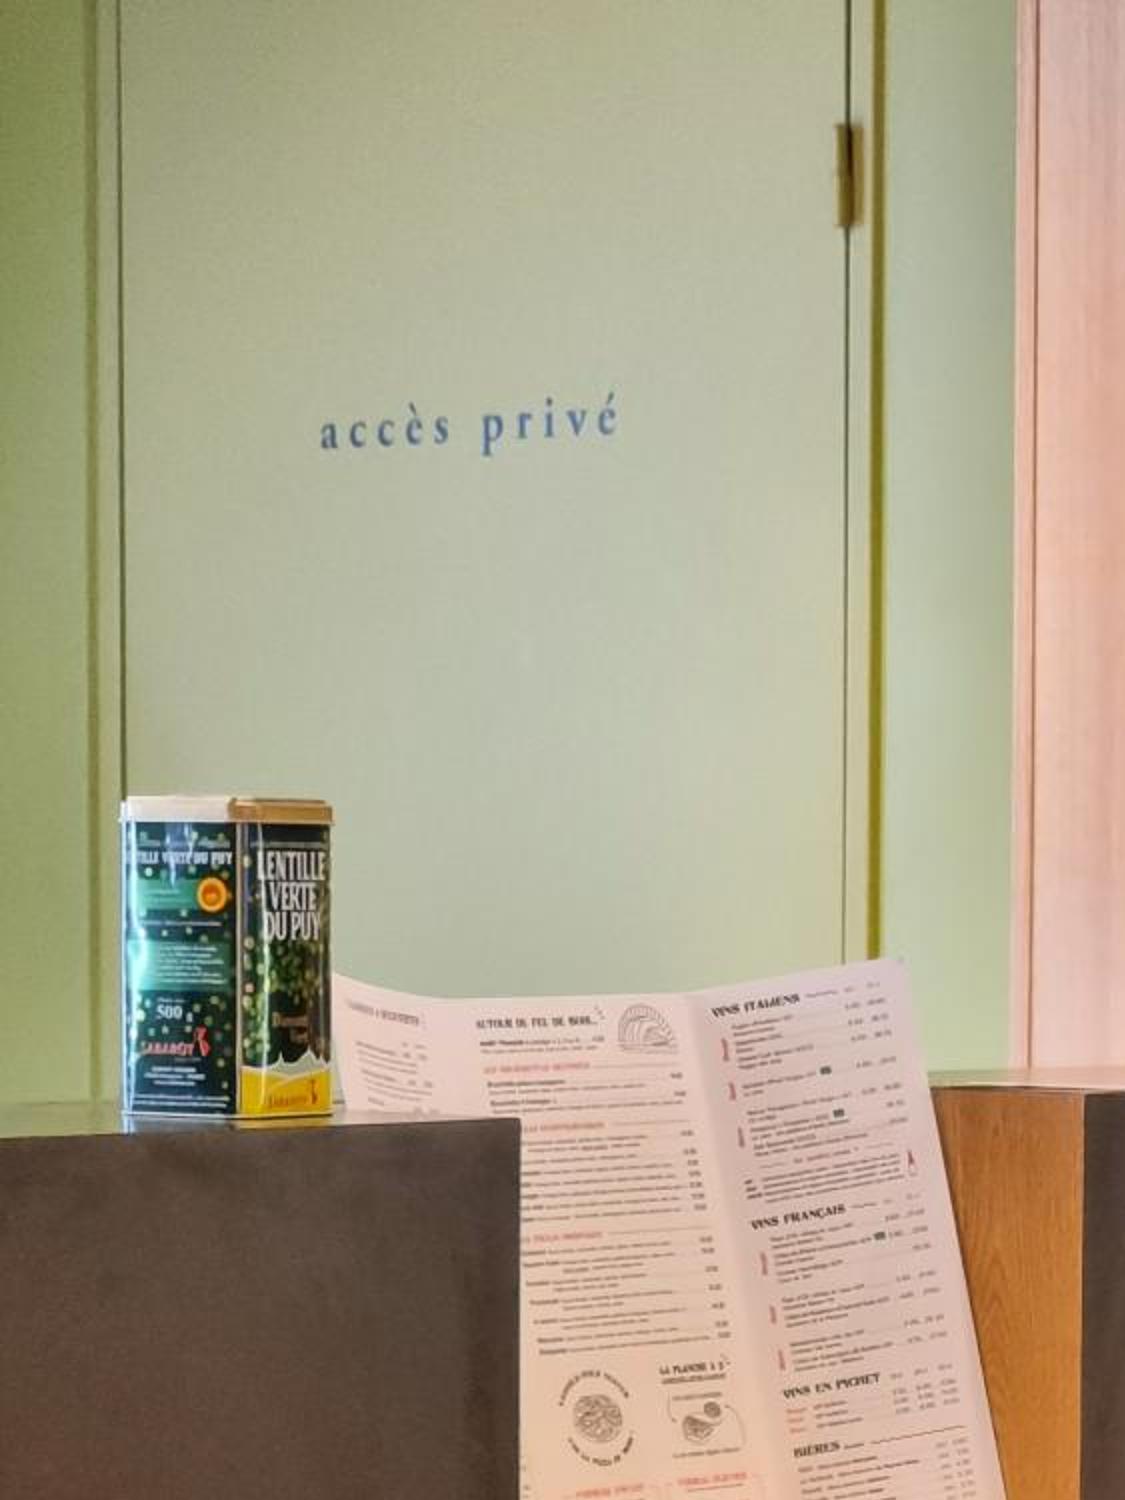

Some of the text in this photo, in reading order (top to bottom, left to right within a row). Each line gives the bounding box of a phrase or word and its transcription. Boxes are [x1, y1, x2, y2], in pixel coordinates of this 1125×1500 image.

[320, 391, 617, 457] accès privé
[210, 851, 233, 865] PUY
[257, 850, 327, 882] LENTILLE
[271, 881, 317, 912] VERTE
[264, 911, 323, 943] DU PUY
[156, 1004, 183, 1020] 500
[743, 993, 801, 1013] ITALIENS
[750, 1203, 846, 1231] VINS FRANÇAIS
[815, 1381, 832, 1393] EN
[793, 1441, 841, 1458] BIÈRES
